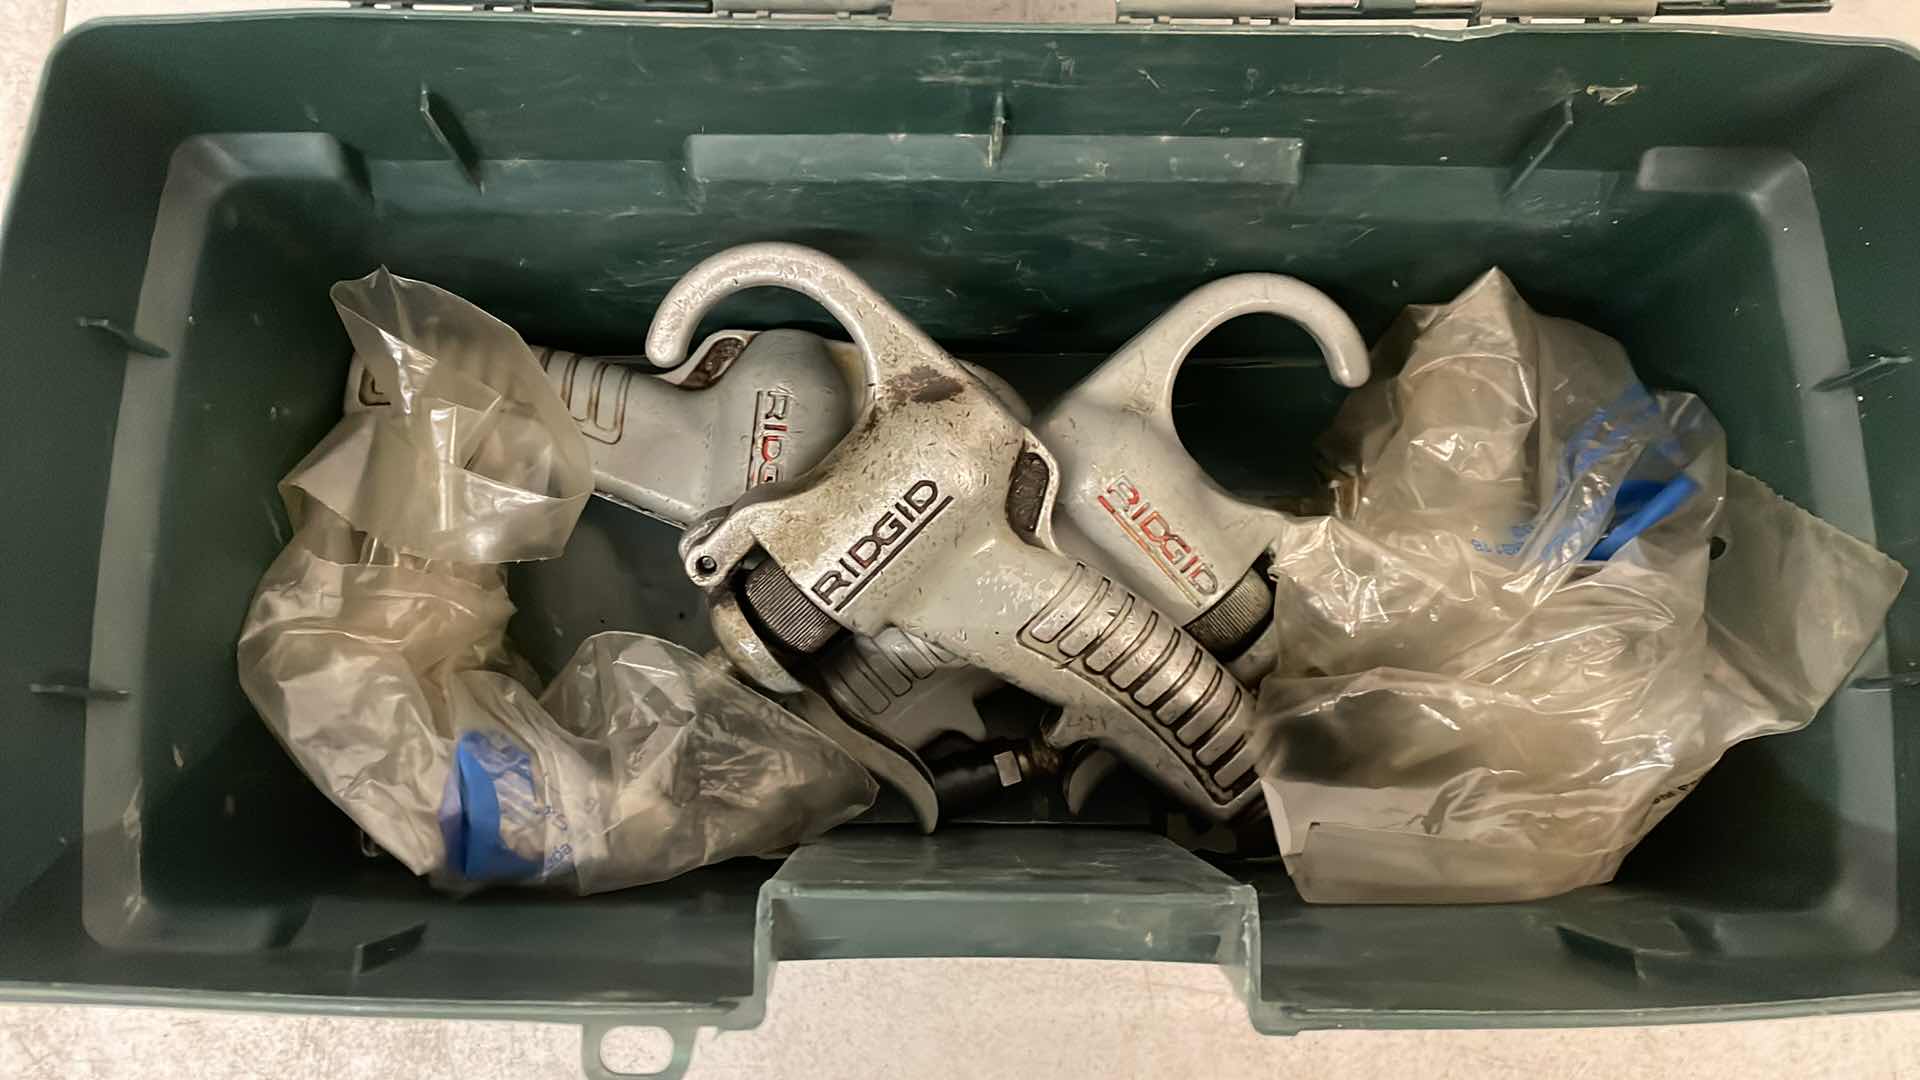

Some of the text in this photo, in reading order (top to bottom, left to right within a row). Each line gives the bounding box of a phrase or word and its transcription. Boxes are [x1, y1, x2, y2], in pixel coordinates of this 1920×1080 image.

[758, 388, 792, 484] RIDG
[811, 479, 939, 606] RIDGID
[1106, 475, 1218, 596] RIDGID
